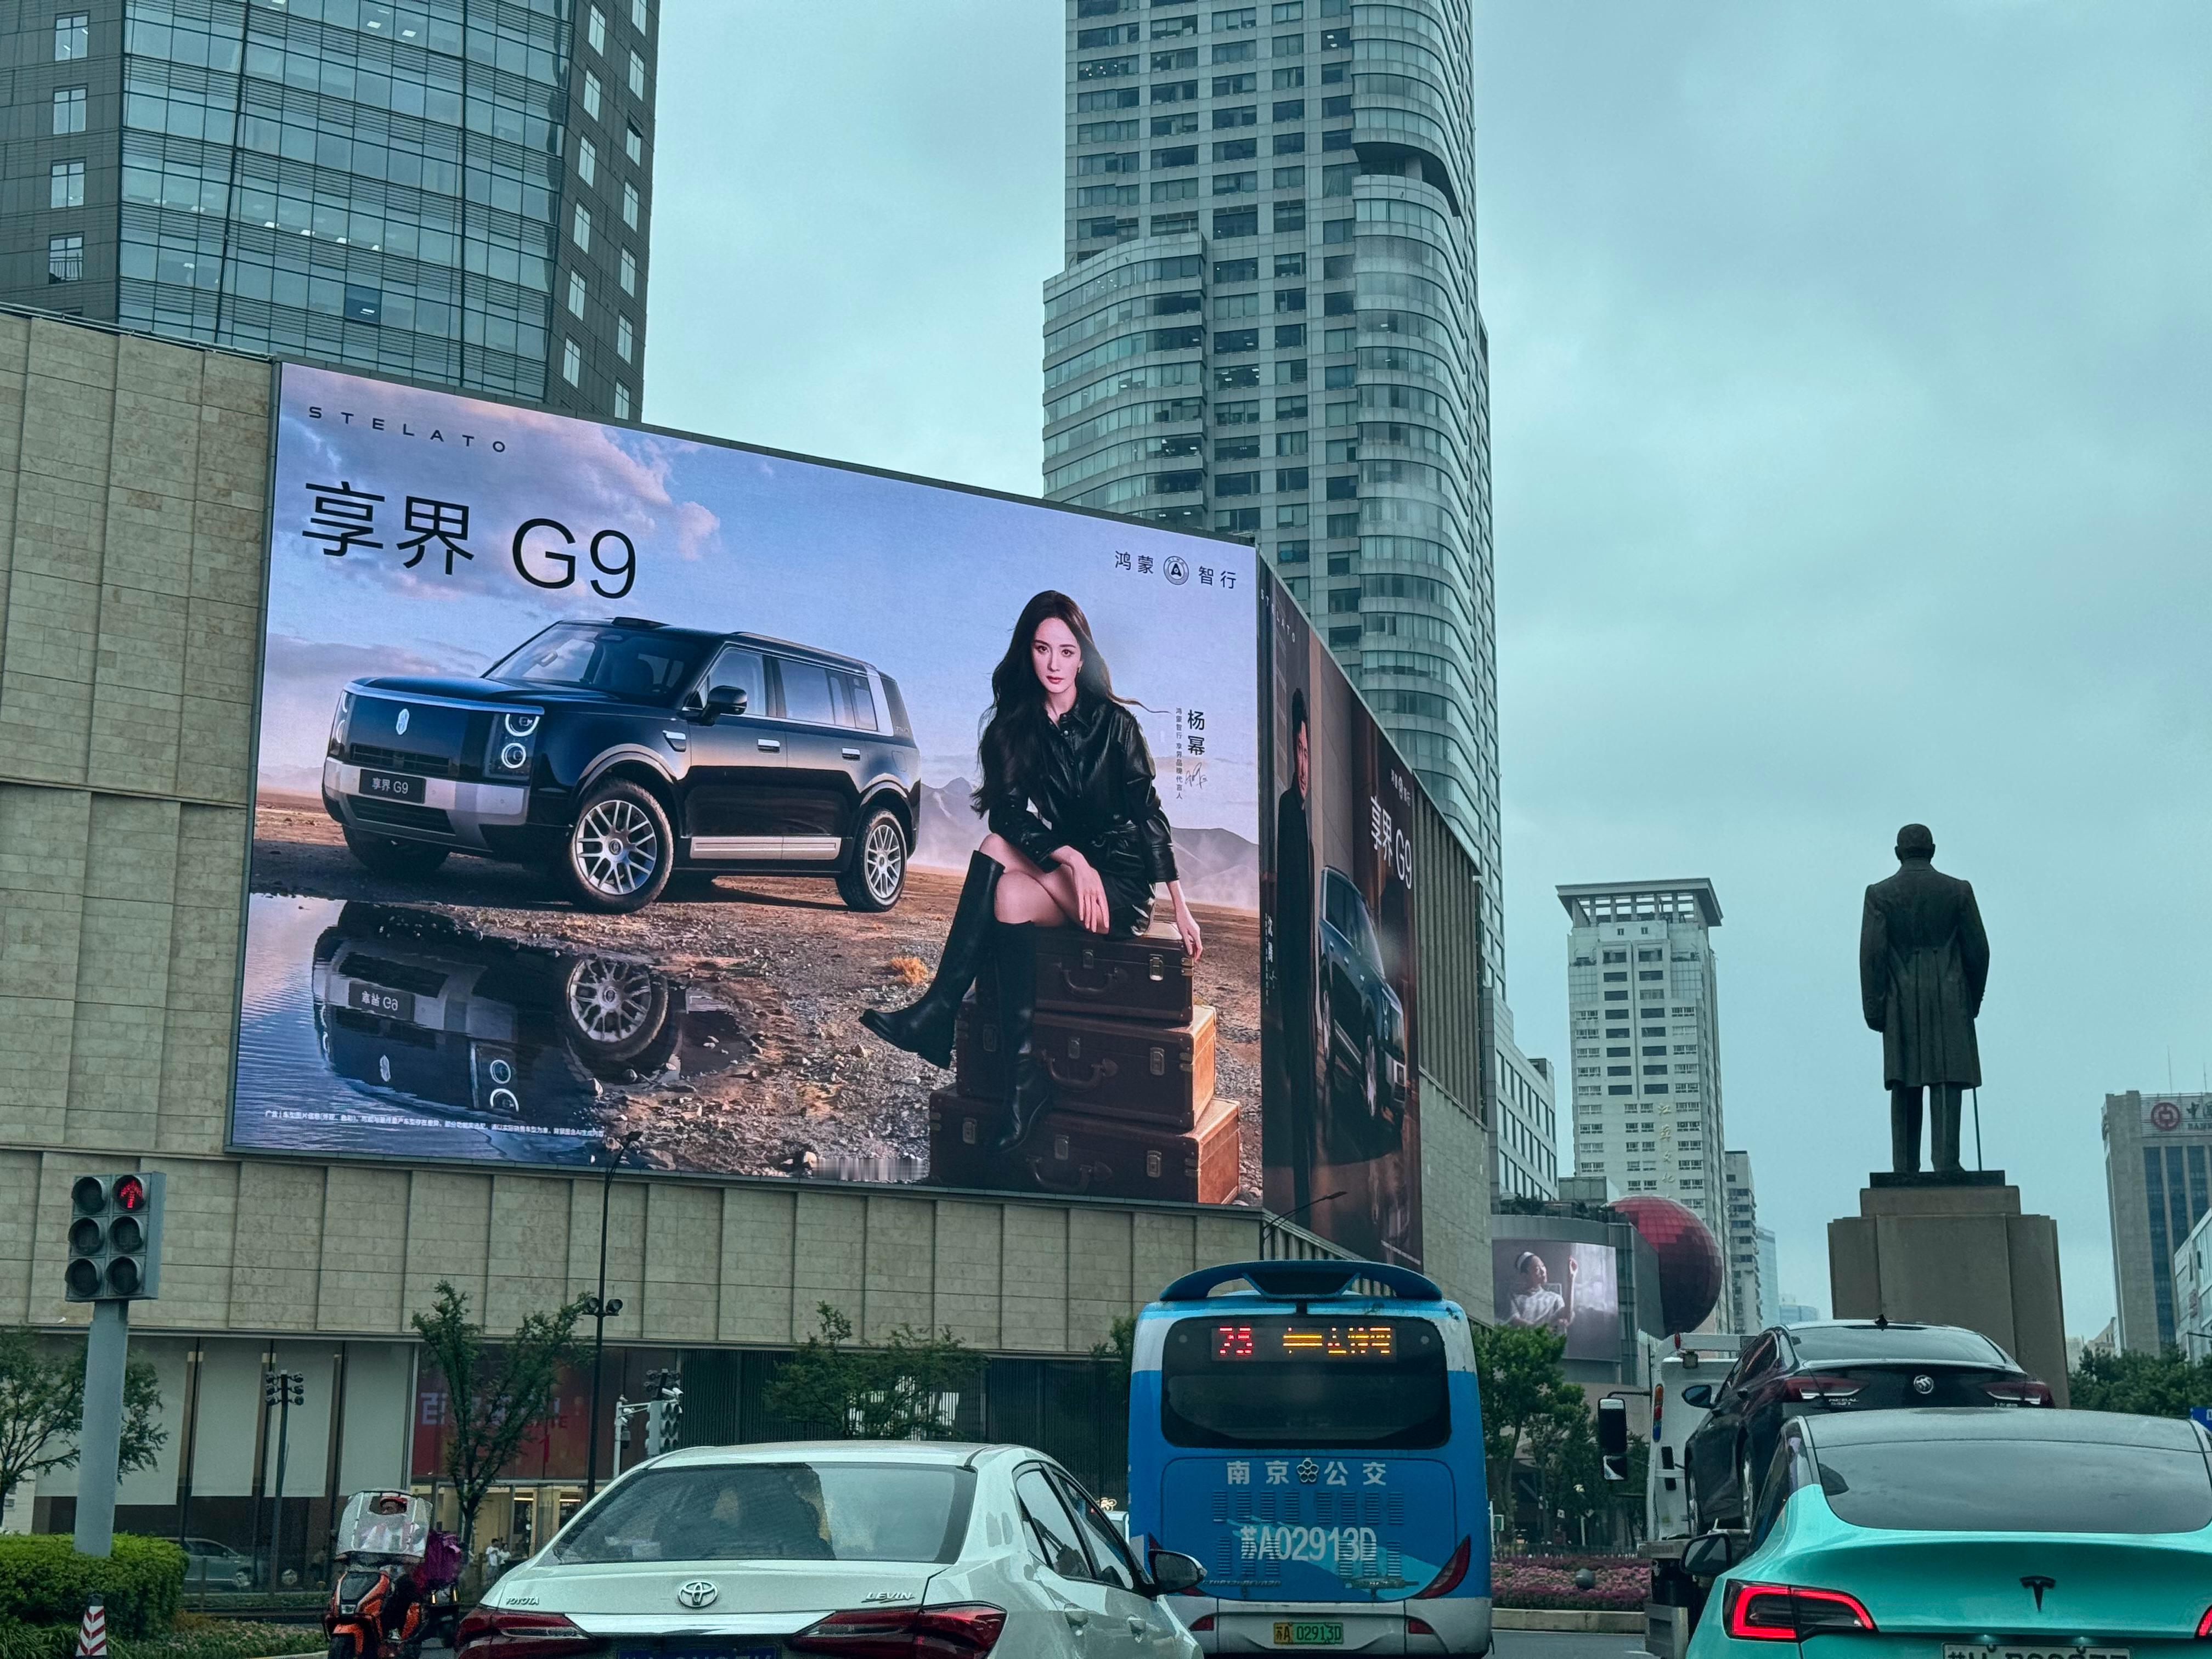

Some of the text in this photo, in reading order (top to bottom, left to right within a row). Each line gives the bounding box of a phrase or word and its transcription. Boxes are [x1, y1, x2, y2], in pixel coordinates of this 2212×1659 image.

[309, 406, 506, 453] STELATO
[302, 481, 636, 599] 享界 G9
[1115, 550, 1237, 590] 鸿蒙 智行
[1187, 709, 1205, 756] 杨幂
[372, 777, 409, 794] 享界 G9
[1370, 795, 1393, 867] 享界
[1396, 828, 1412, 890] G9
[1226, 1460, 1386, 1486] 南京 公交
[1239, 1525, 1377, 1562] 苏A02913D
[505, 1596, 540, 1606] TOYOTA
[865, 1591, 913, 1601] LEVIN
